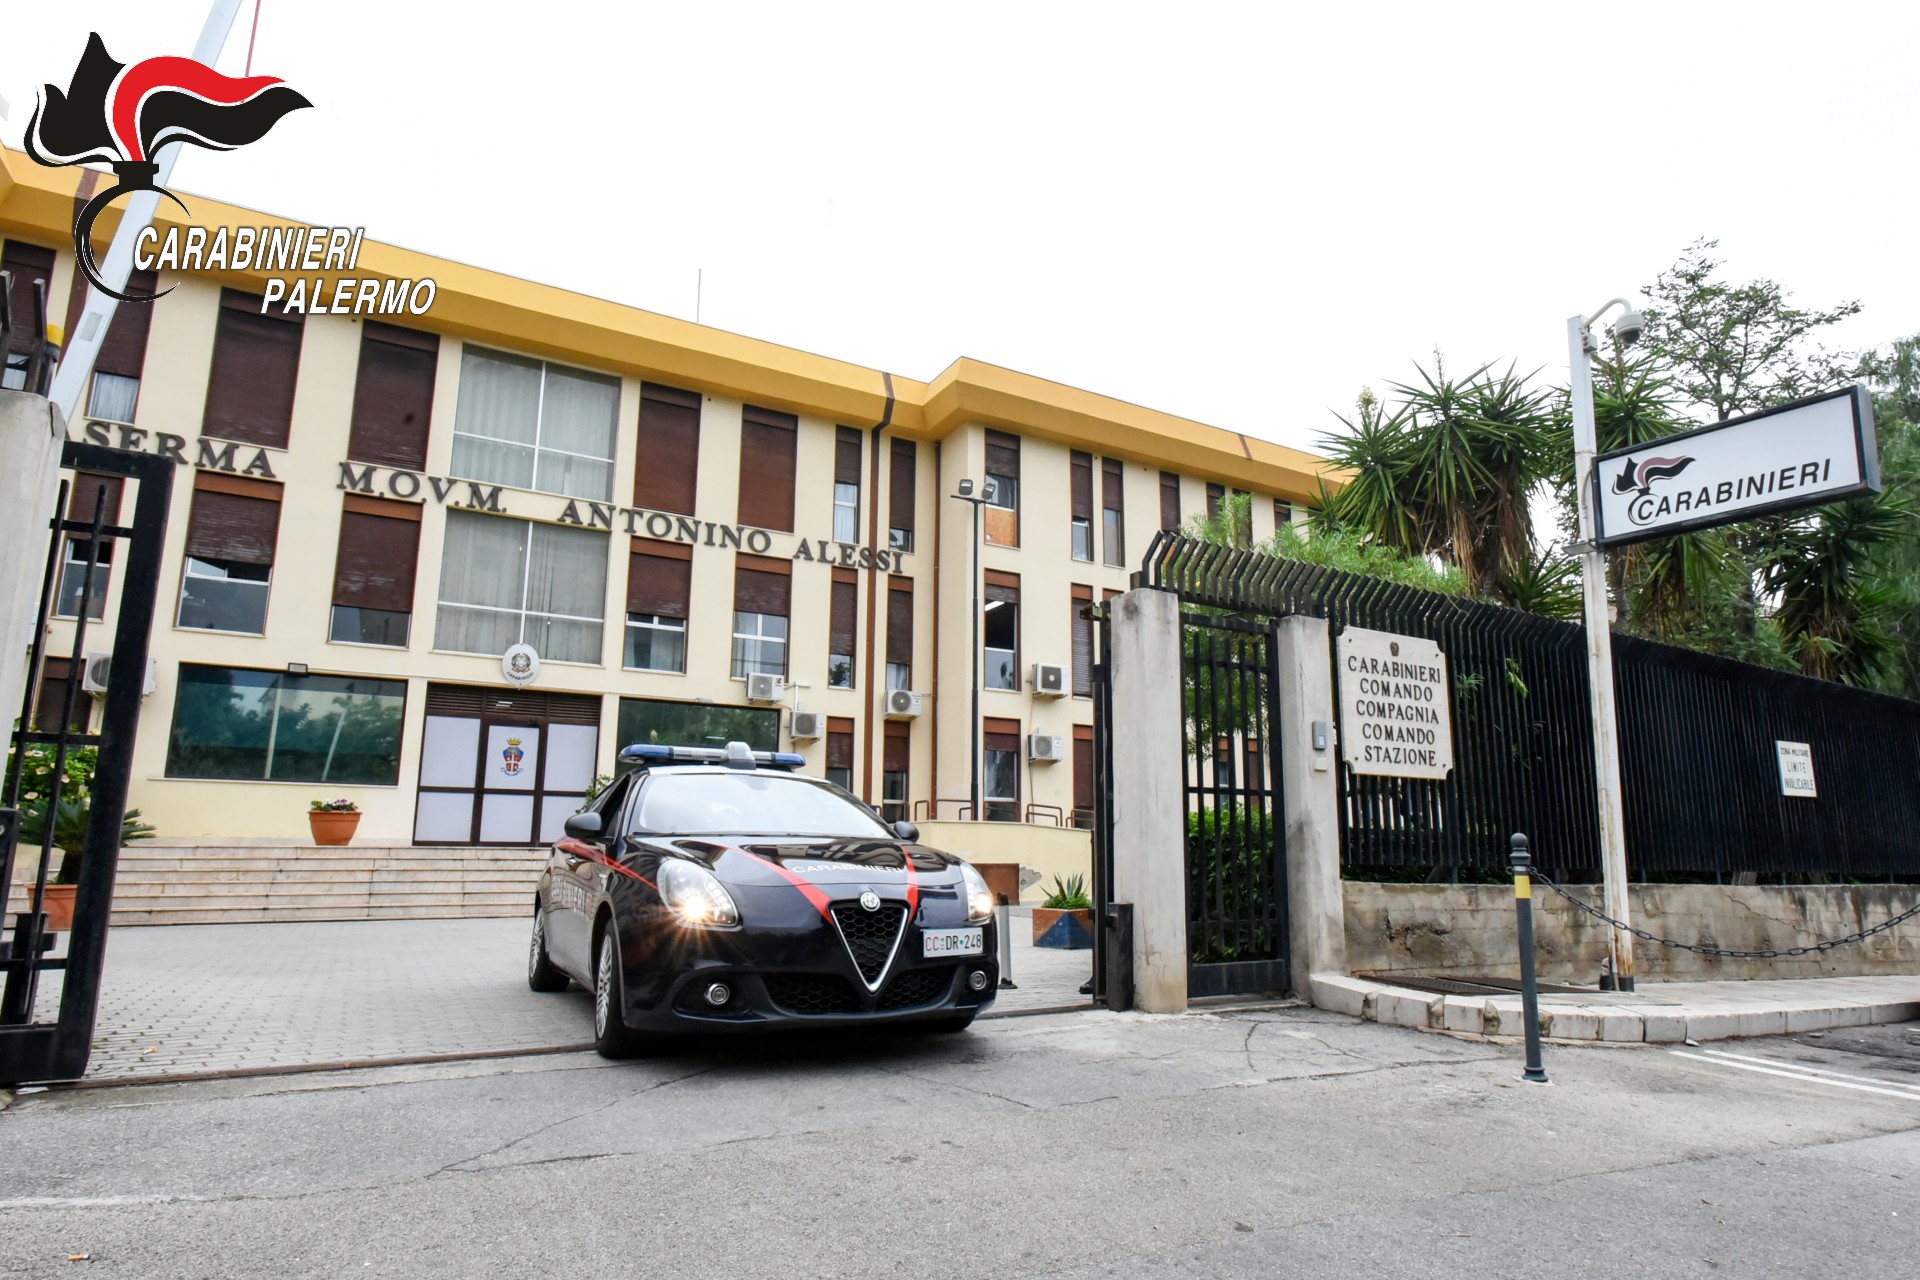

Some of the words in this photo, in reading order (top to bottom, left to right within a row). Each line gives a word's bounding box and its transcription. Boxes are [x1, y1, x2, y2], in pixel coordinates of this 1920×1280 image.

[1637, 458, 1831, 521] CARABINIERI
[336, 461, 507, 513] M.O.V.M.
[557, 499, 771, 554] ANTONINO
[793, 537, 903, 574] ALESSI
[1348, 656, 1441, 683] CARABINIERI
[1360, 678, 1433, 702] COMANDO
[1356, 700, 1439, 724] COMPAGNIA
[1362, 723, 1435, 745] COMANDO
[1364, 745, 1437, 767] STAZIONE
[1787, 761, 1806, 773] LIMITE
[792, 863, 905, 874] CARABINIERI
